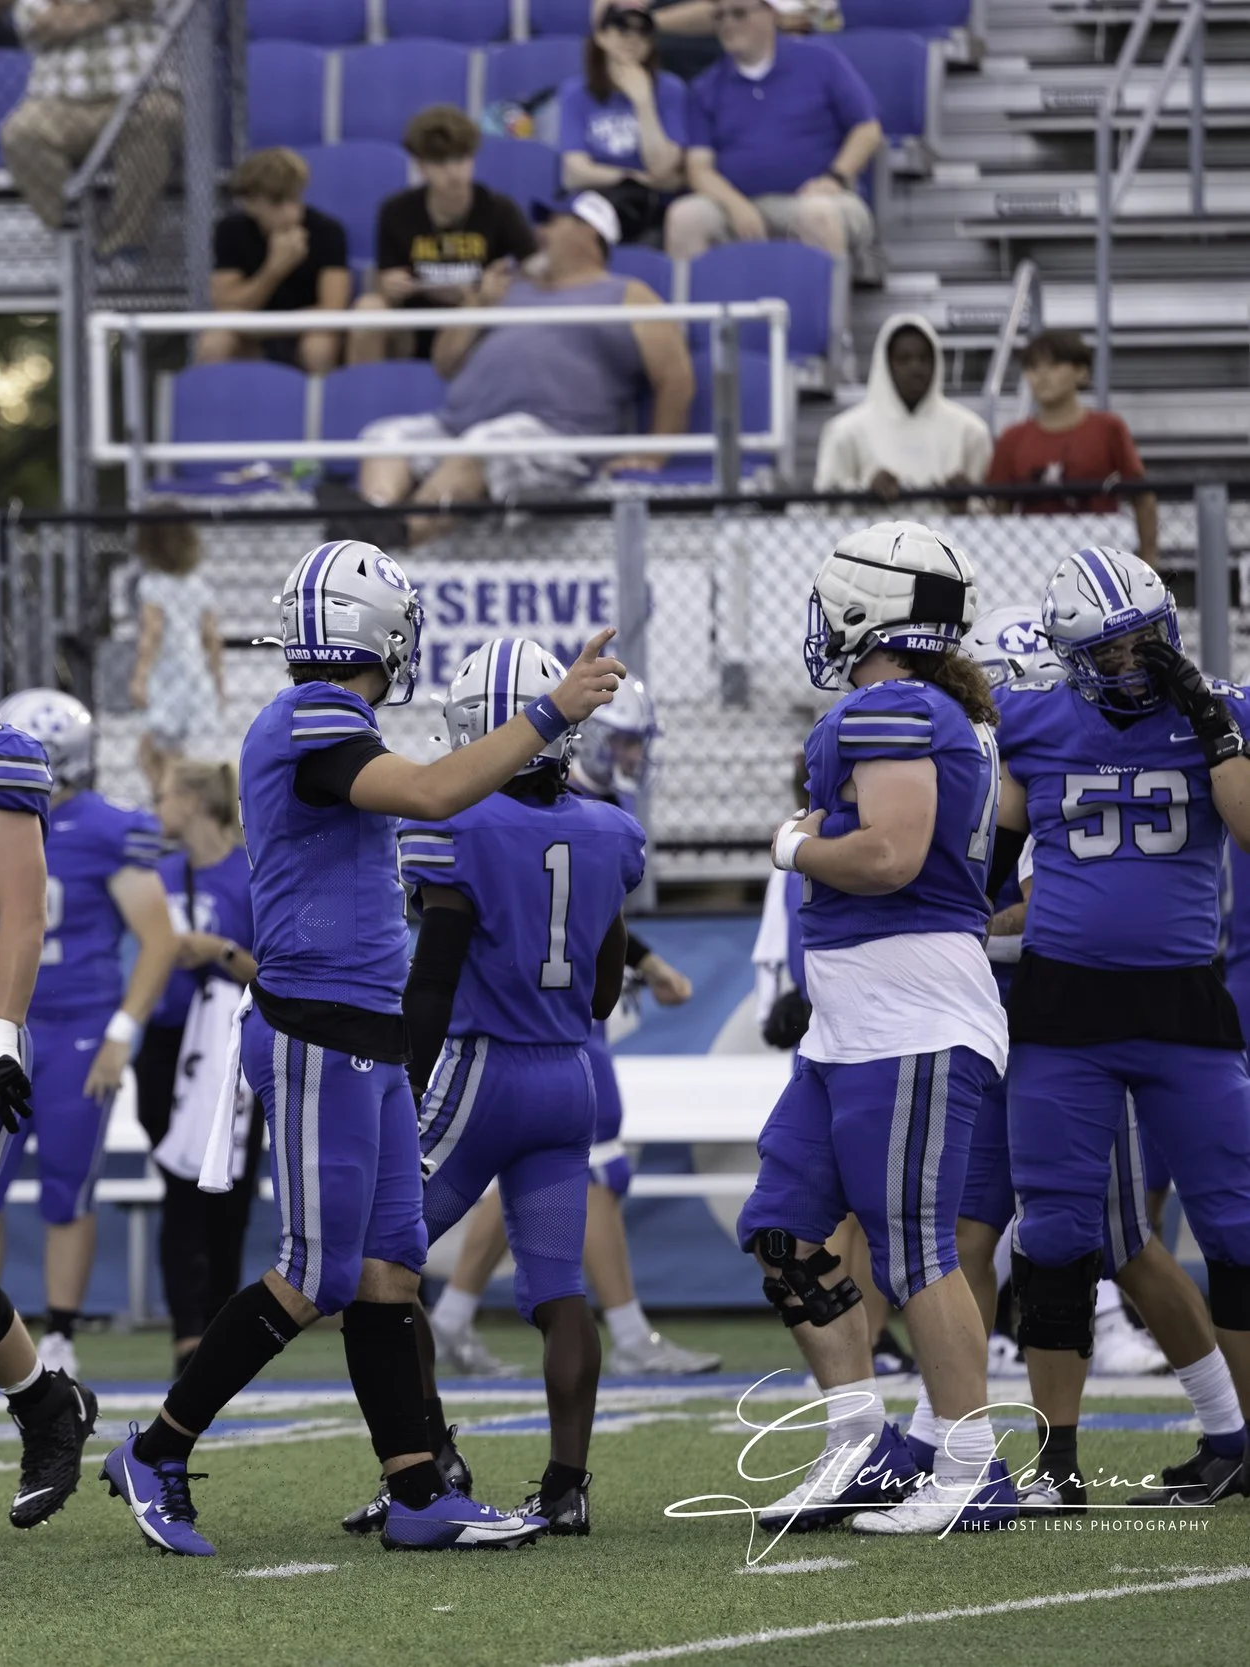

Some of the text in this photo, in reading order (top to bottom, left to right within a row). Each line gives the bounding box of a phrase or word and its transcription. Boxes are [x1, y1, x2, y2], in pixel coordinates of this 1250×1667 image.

[412, 580, 652, 627] SERVE
[1106, 609, 1138, 627] Vikings
[907, 636, 944, 653] HARD
[1002, 623, 1050, 654] M
[286, 648, 356, 662] HARD WAY
[1061, 770, 1190, 861] 53
[538, 841, 573, 990] 1
